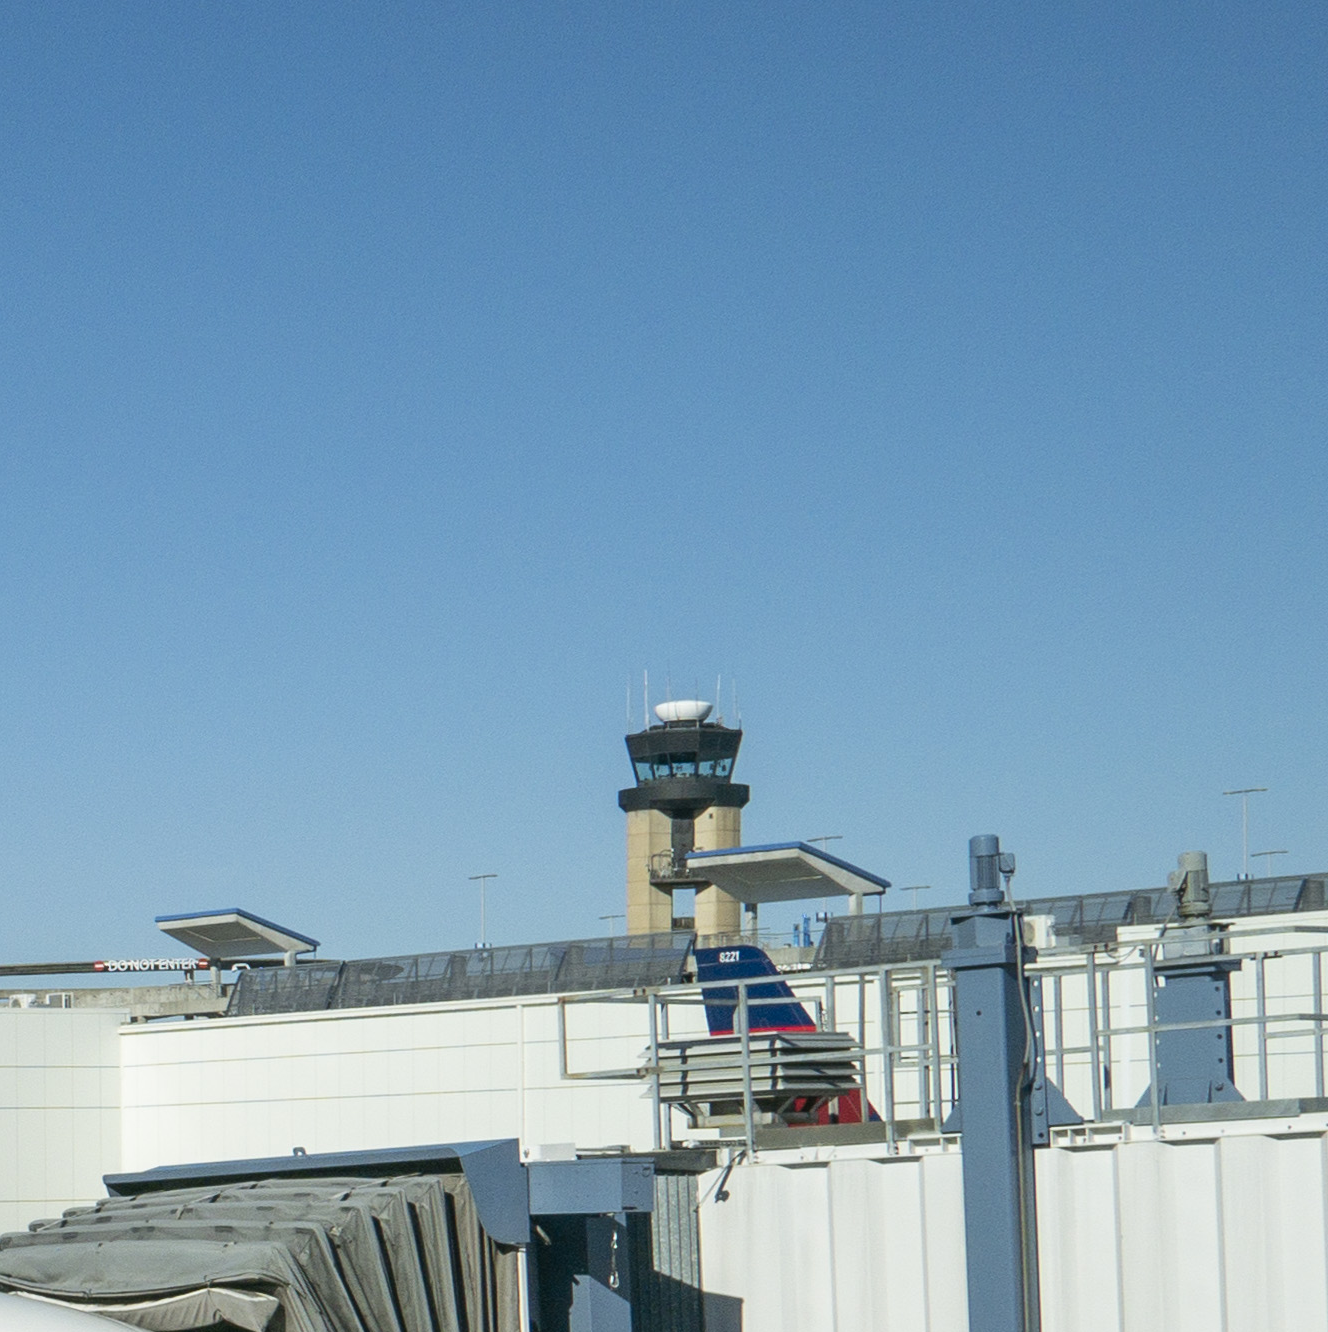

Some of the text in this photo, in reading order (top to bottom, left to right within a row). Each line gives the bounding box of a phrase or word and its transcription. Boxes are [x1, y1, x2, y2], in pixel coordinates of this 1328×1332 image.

[108, 957, 197, 972] DO NOT ENTER
